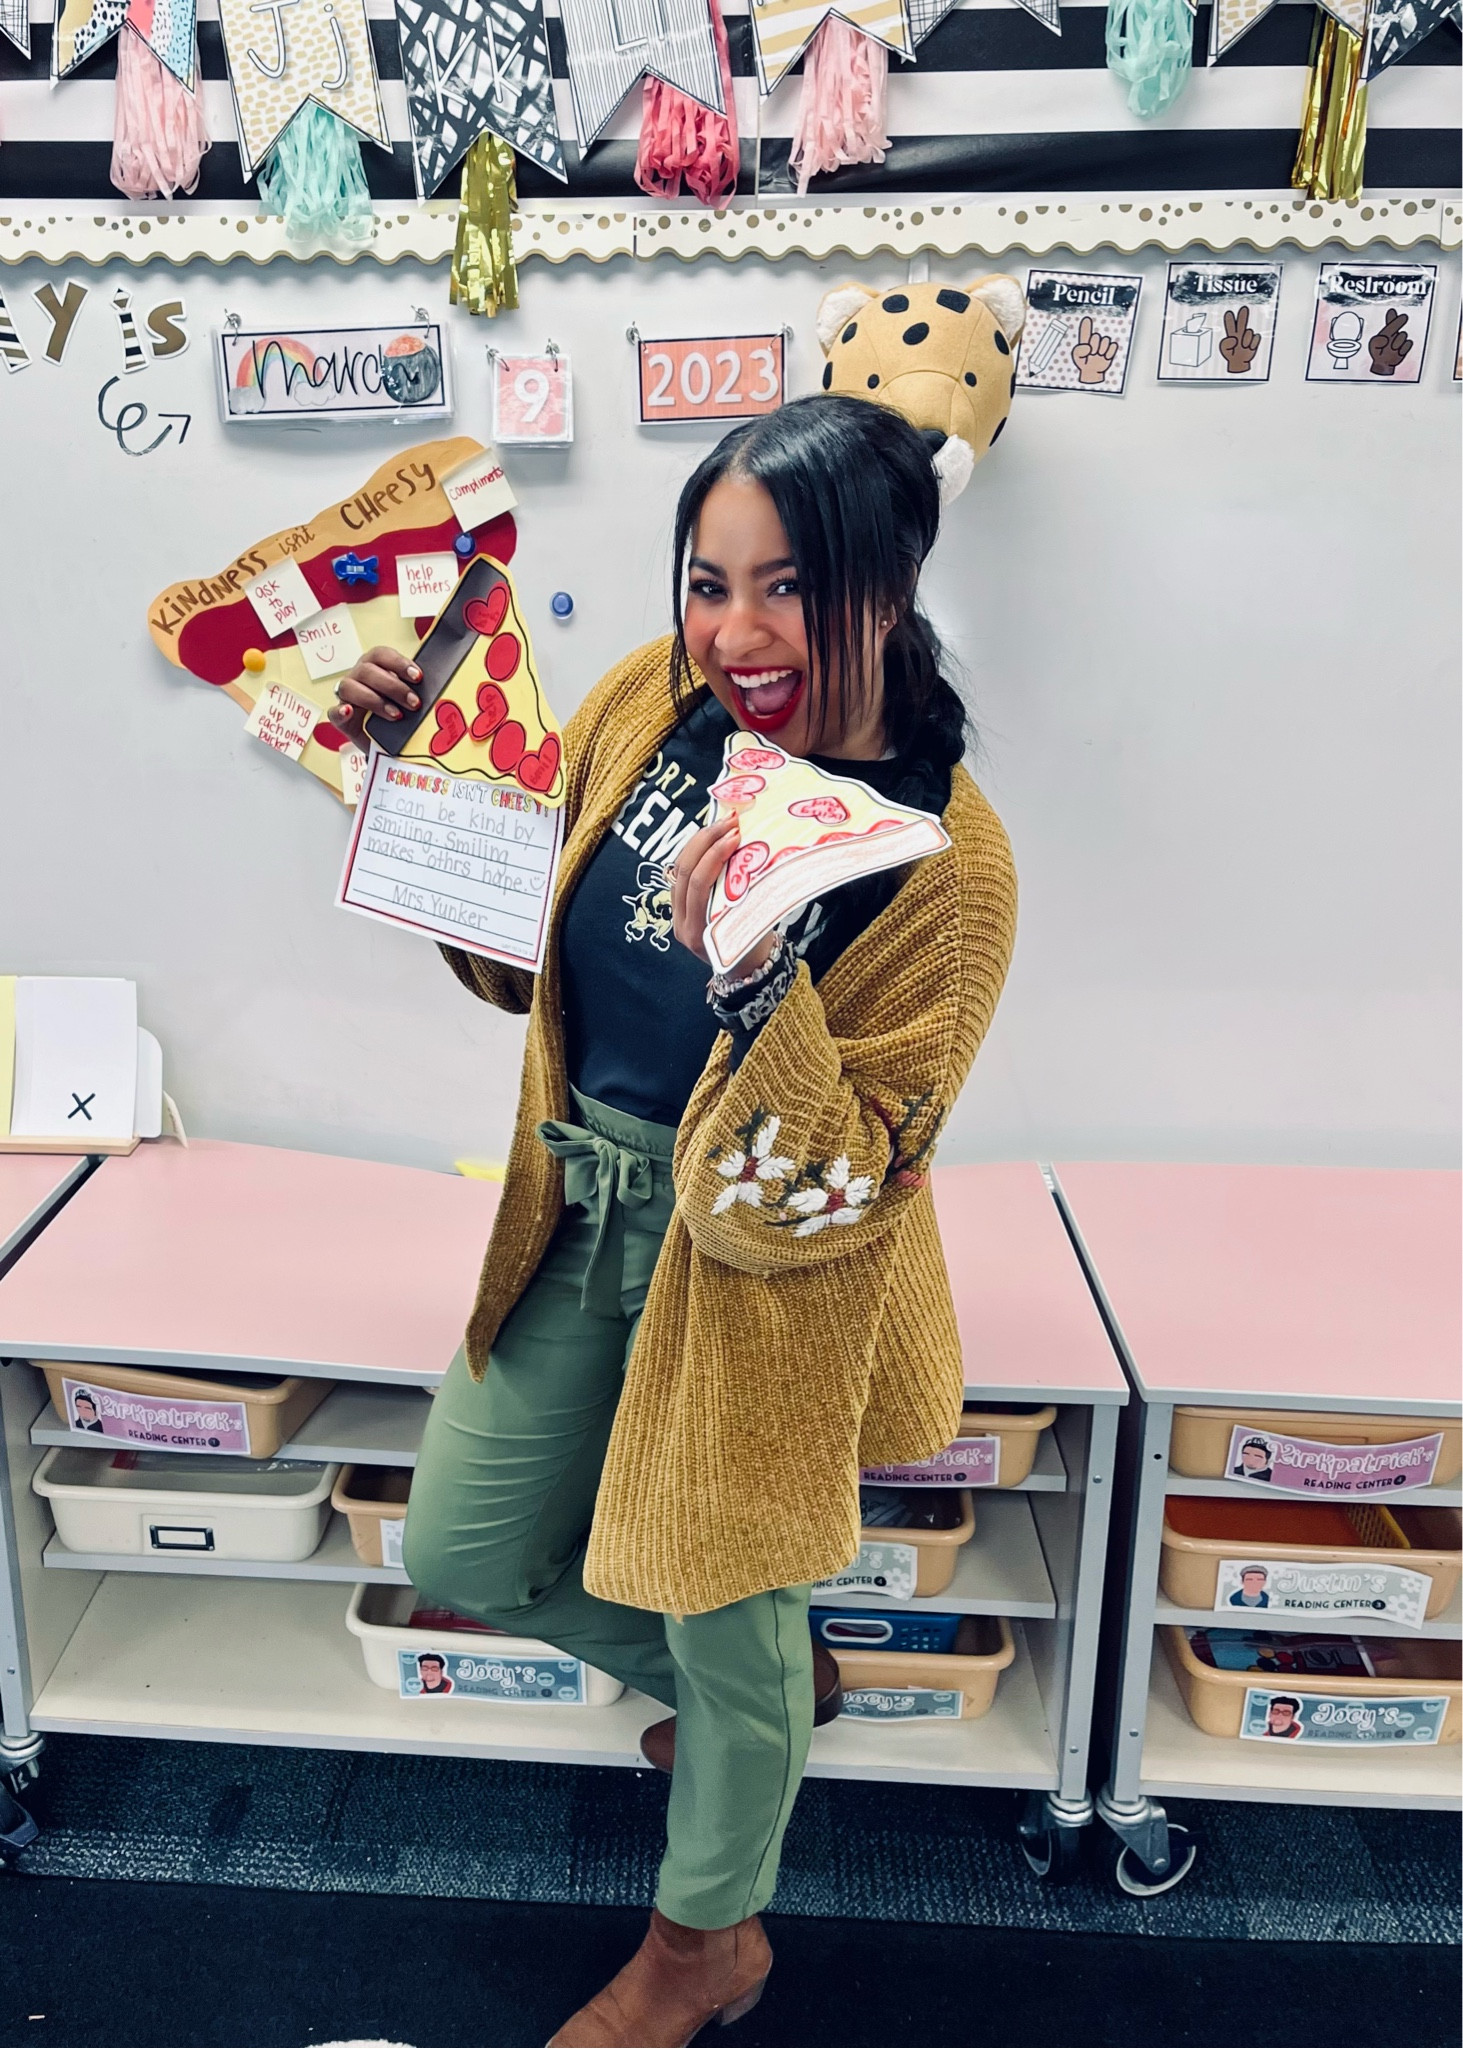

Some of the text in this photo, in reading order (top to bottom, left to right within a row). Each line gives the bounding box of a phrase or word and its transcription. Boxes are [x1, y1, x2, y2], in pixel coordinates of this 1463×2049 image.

[1053, 282, 1115, 306] Pencil
[1195, 273, 1259, 295] Tissue
[112, 287, 188, 370] is
[647, 350, 780, 407] 2023
[513, 368, 550, 423] 9
[405, 564, 434, 583] help
[255, 579, 281, 599] ask
[409, 578, 451, 596] others
[268, 597, 284, 610] to
[274, 601, 298, 625] play
[298, 620, 342, 643] smile
[268, 704, 285, 724] up
[269, 685, 312, 728] filling
[258, 715, 284, 737] each
[386, 766, 450, 796] KINDNESS
[453, 780, 488, 804] ISN'T
[378, 788, 390, 809] I
[396, 799, 425, 820] can
[437, 801, 456, 824] be
[470, 809, 505, 837] kind
[514, 821, 536, 851] by
[367, 836, 414, 864] makes
[427, 852, 472, 878] othrs
[446, 831, 509, 876] Smiling
[392, 884, 489, 929] Mrs. Yunker
[128, 1429, 168, 1443] READING
[171, 1436, 207, 1447] CENTER
[863, 1472, 910, 1482] READING
[913, 1473, 953, 1482] CENTER
[1303, 1478, 1352, 1490] READING
[1355, 1478, 1393, 1490] CENTER
[836, 1576, 873, 1586] CENTER
[1277, 1570, 1388, 1596] Justin's
[1284, 1599, 1330, 1609] READING
[1333, 1600, 1372, 1609] CENTER
[456, 1658, 537, 1688] Joey's
[1310, 1702, 1400, 1731] Joey's
